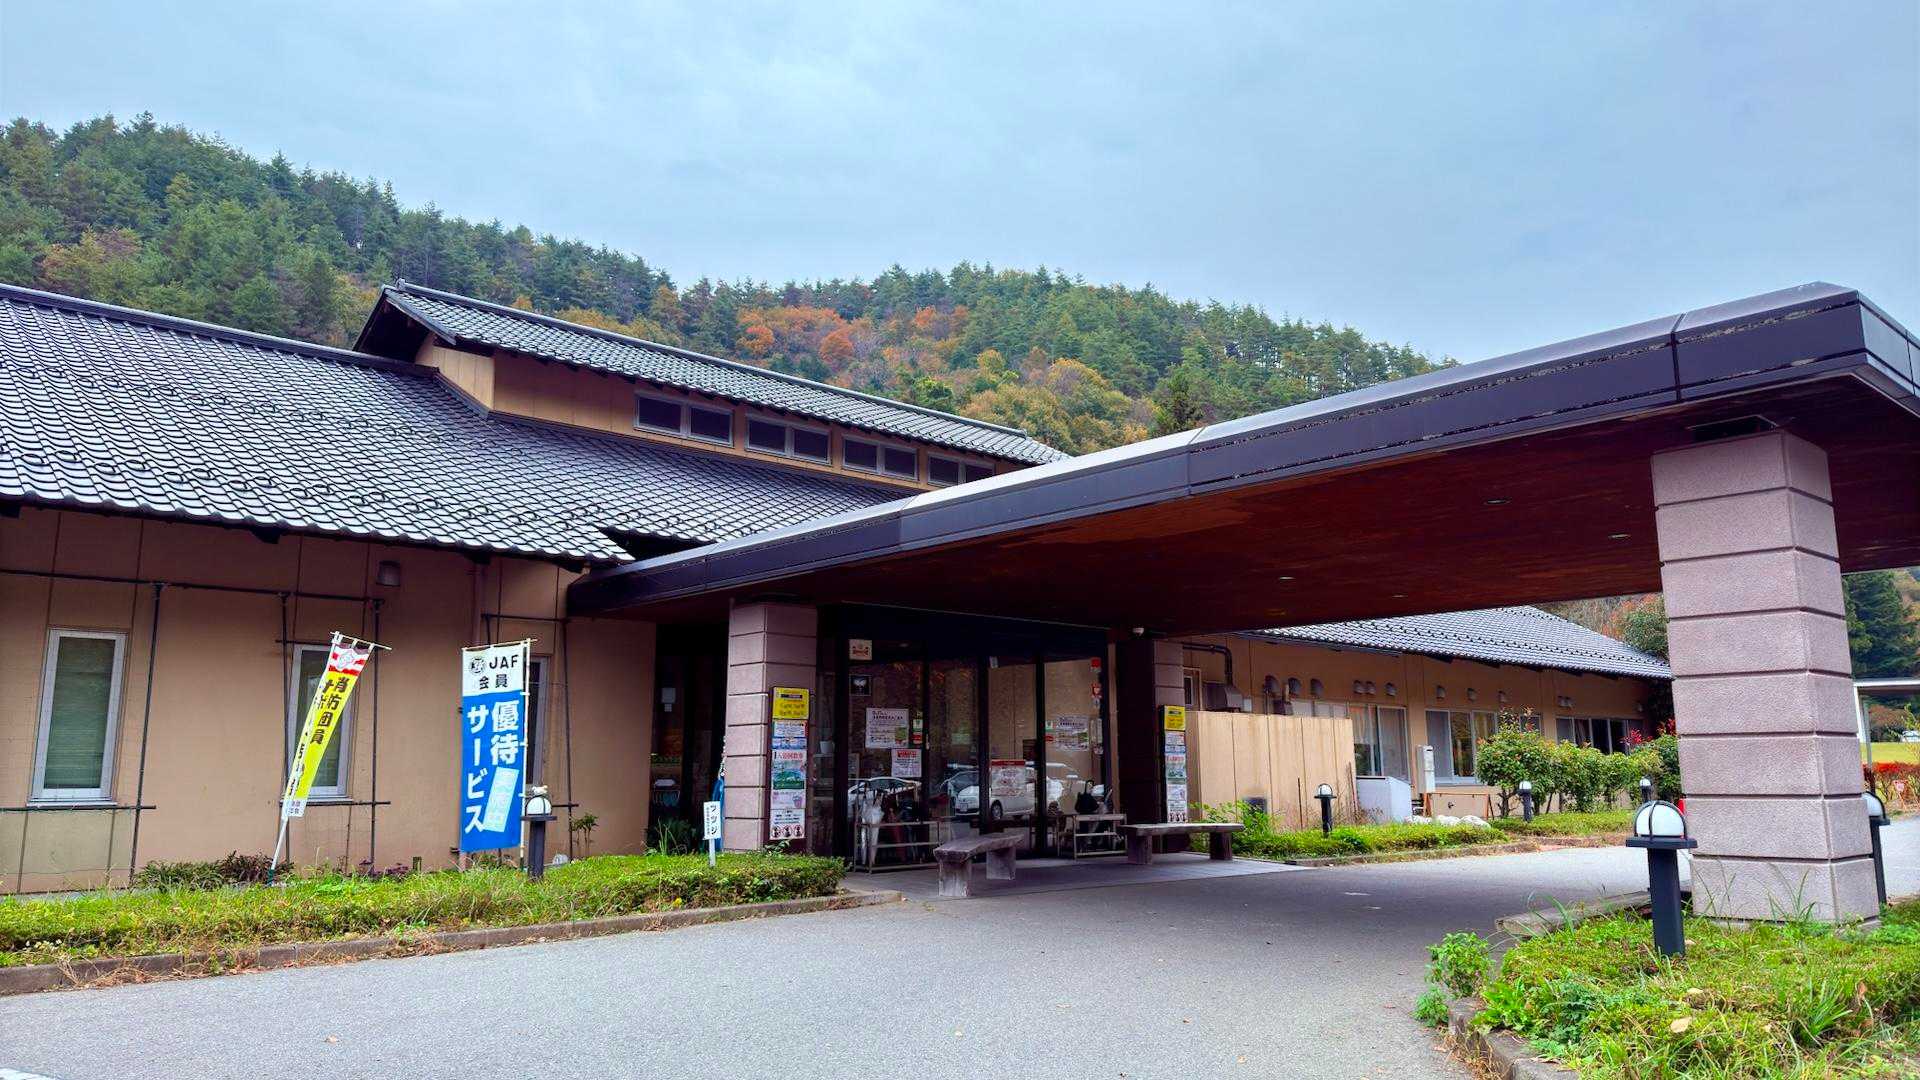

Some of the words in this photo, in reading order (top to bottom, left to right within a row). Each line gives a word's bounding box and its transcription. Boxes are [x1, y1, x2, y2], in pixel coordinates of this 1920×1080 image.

[479, 673, 508, 690] 会員
[489, 654, 519, 669] JAF
[490, 699, 520, 766] 優待
[465, 704, 489, 834] サービス
